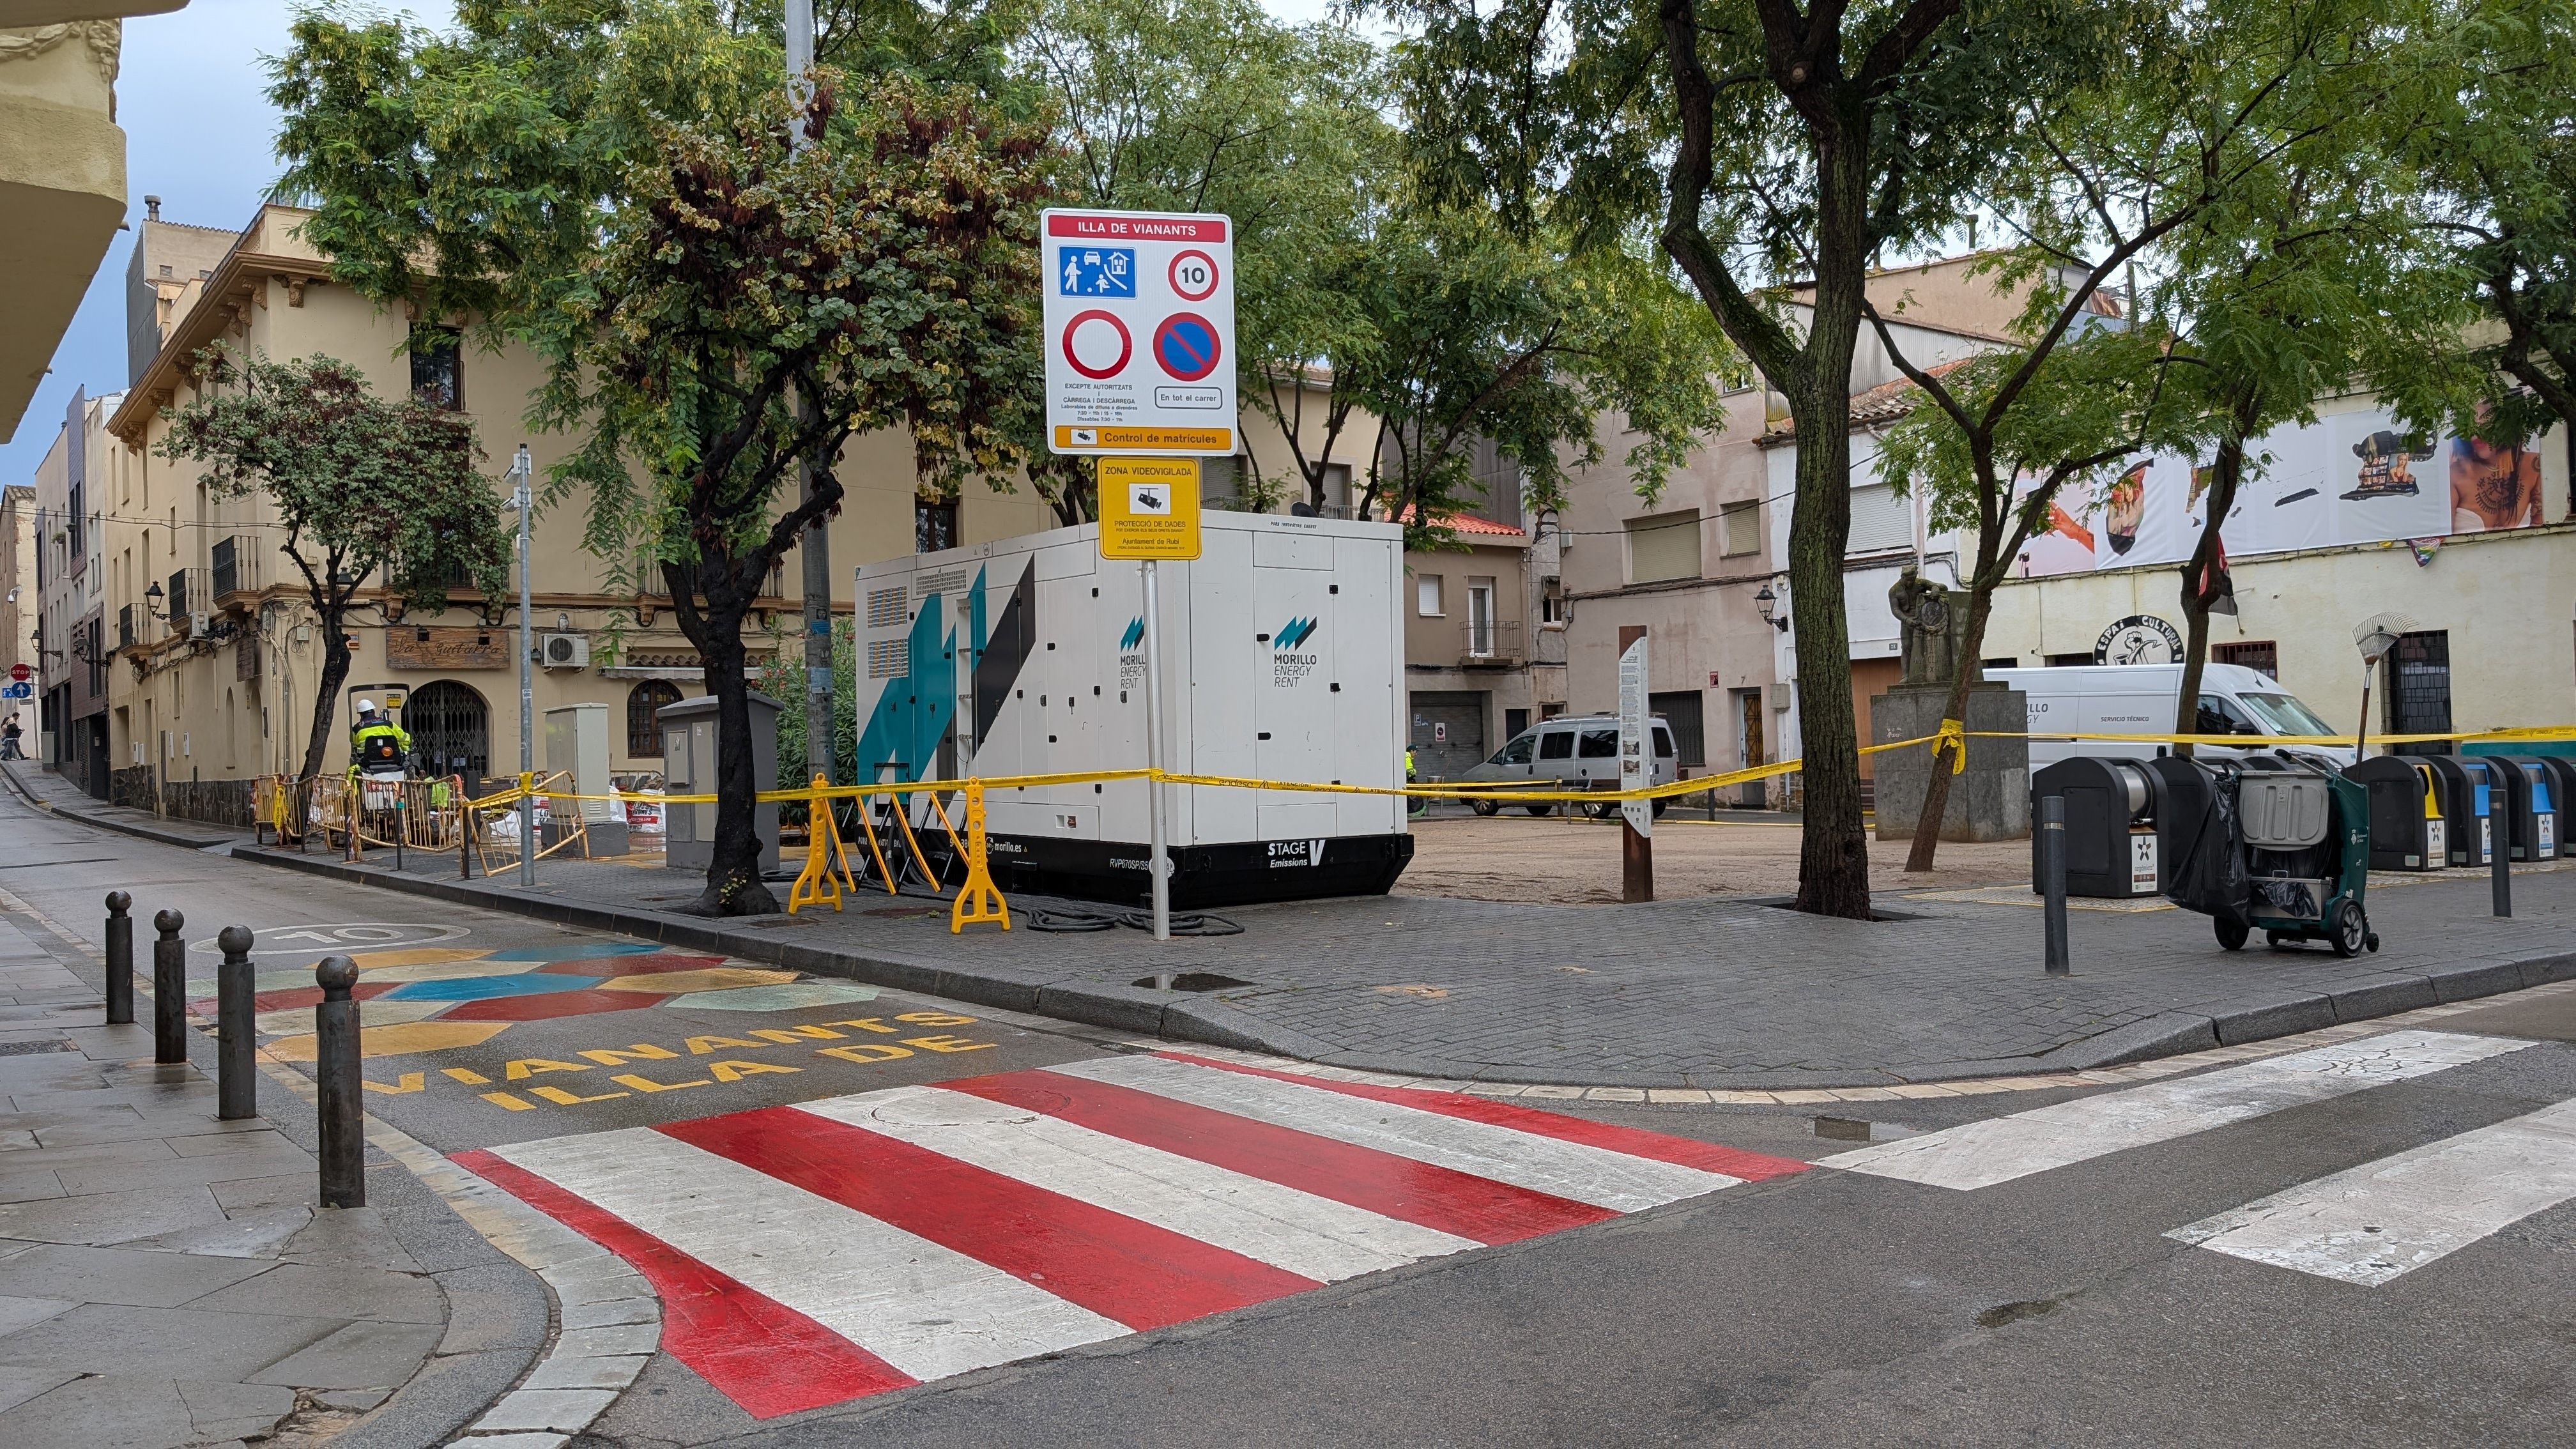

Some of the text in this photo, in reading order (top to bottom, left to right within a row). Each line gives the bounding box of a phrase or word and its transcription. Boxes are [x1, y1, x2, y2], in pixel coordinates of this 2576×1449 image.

[1078, 221, 1197, 236] ILLA DE VIANANTS
[1181, 266, 1206, 284] 10
[1172, 394, 1183, 402] tot
[1185, 394, 1192, 402] el
[1104, 433, 1217, 444] Control de matrícules
[1105, 466, 1192, 476] ZONA VIDEOVIGILADA
[2141, 616, 2181, 650] CULTURAL
[394, 636, 501, 656] La Guitarra
[1120, 654, 1146, 666] MORILL
[1274, 654, 1317, 665] MORILLO
[1274, 665, 1312, 677] ENERGY
[1120, 677, 1139, 689] RENT
[1274, 677, 1300, 688] RENT
[2026, 703, 2048, 713] ILLO
[1219, 779, 1254, 788] endesa
[994, 841, 1022, 853] morillo.es
[1268, 839, 1326, 867] STAGE V
[1269, 858, 1307, 869] Emissions
[272, 927, 404, 944] 10
[362, 1011, 980, 1094] VIANANTS
[478, 1034, 999, 1110] ILLA DE
